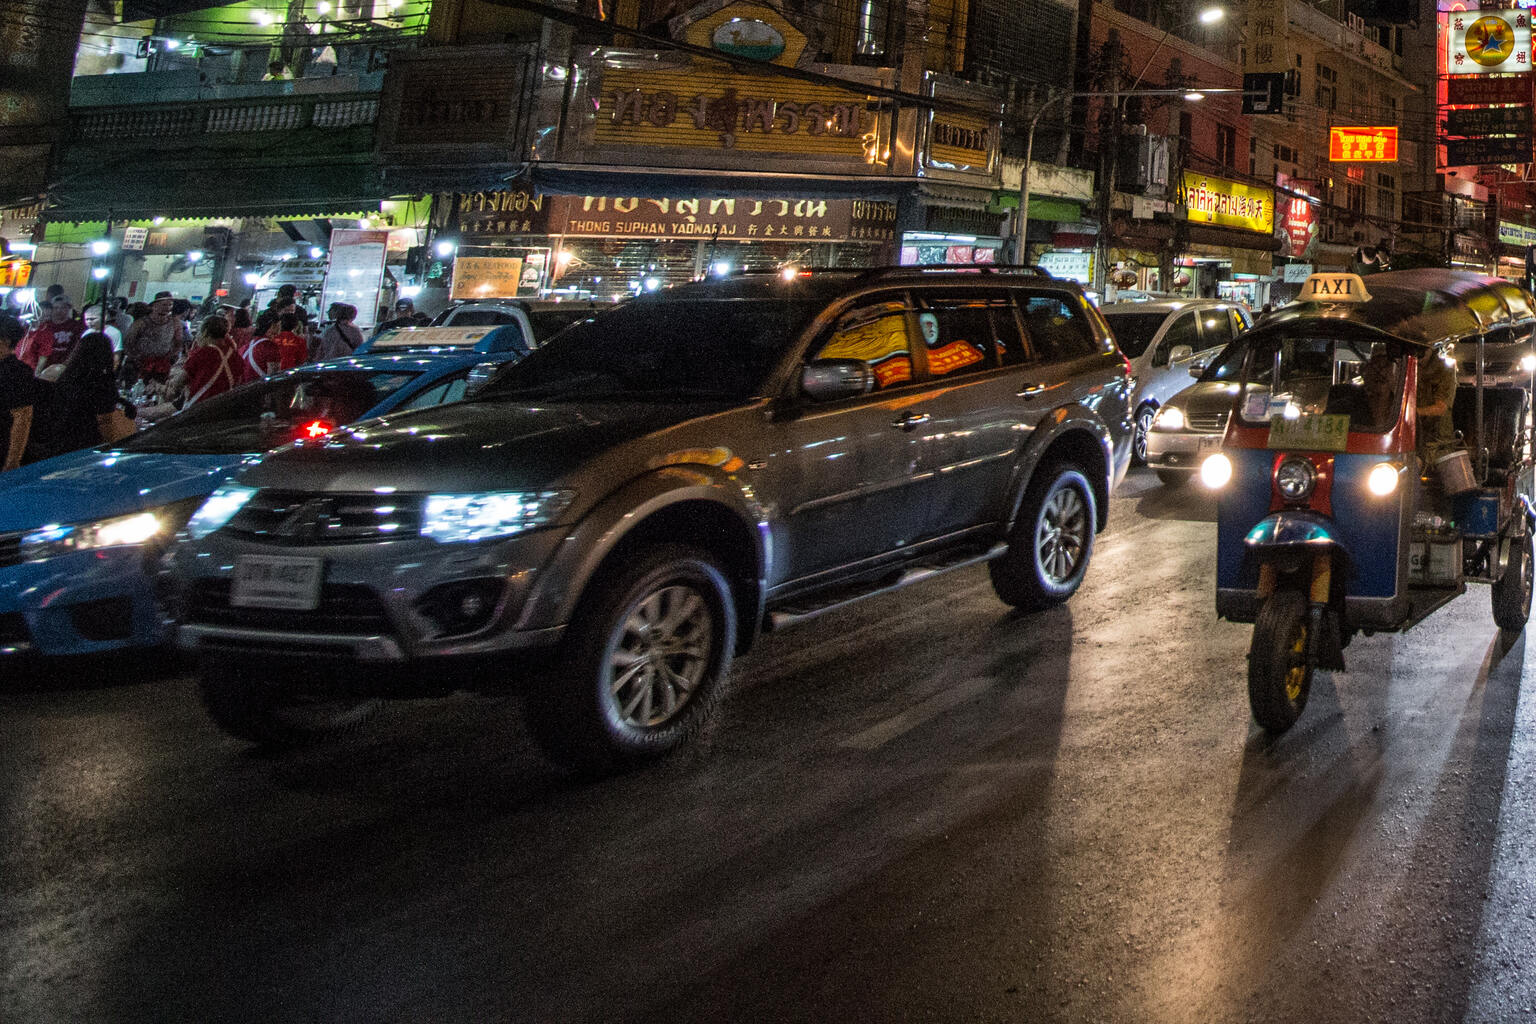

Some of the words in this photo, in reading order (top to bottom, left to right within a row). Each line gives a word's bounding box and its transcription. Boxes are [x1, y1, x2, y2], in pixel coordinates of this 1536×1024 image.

[570, 219, 611, 234] THONG
[615, 220, 667, 235] SUPHAN
[671, 222, 738, 237] YAOWARAJ
[1310, 278, 1353, 294] TAXI
